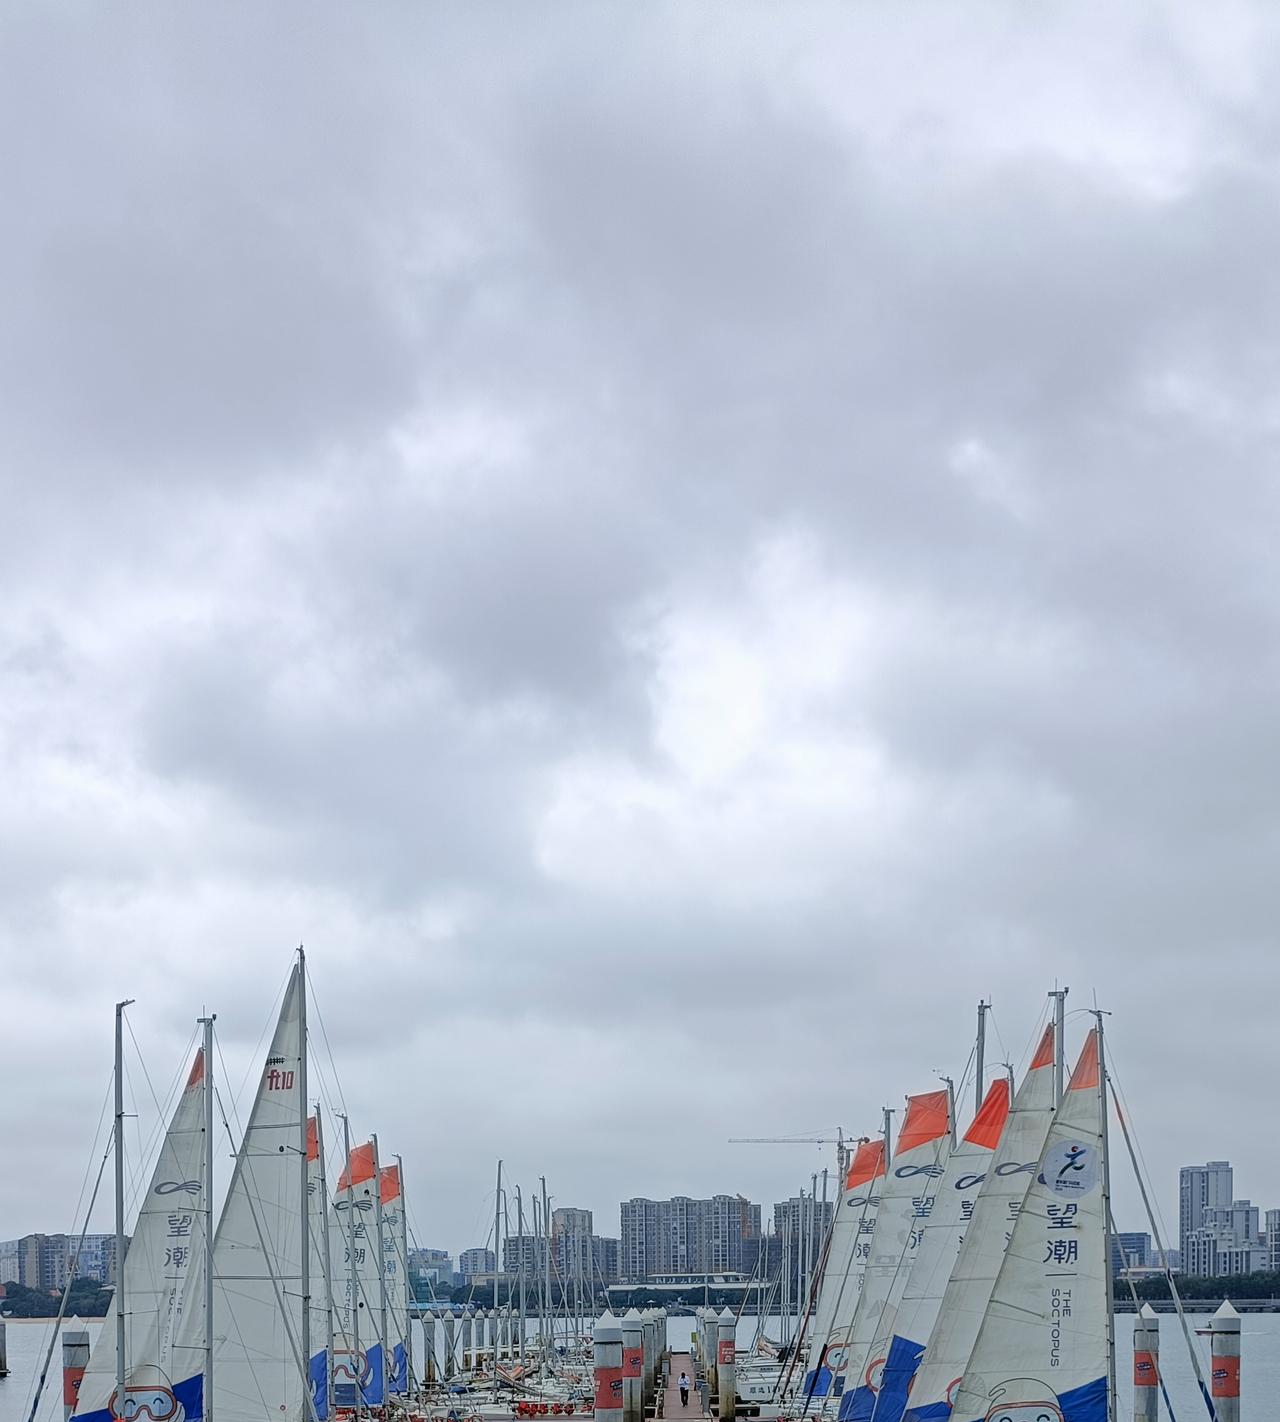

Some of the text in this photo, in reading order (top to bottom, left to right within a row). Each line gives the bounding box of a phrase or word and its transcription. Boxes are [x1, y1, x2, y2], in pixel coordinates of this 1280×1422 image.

[267, 1069, 294, 1090] ft10
[1043, 1203, 1078, 1265] 望潮
[1062, 1289, 1072, 1317] THE
[1050, 1288, 1061, 1368] SOCTOPUS
